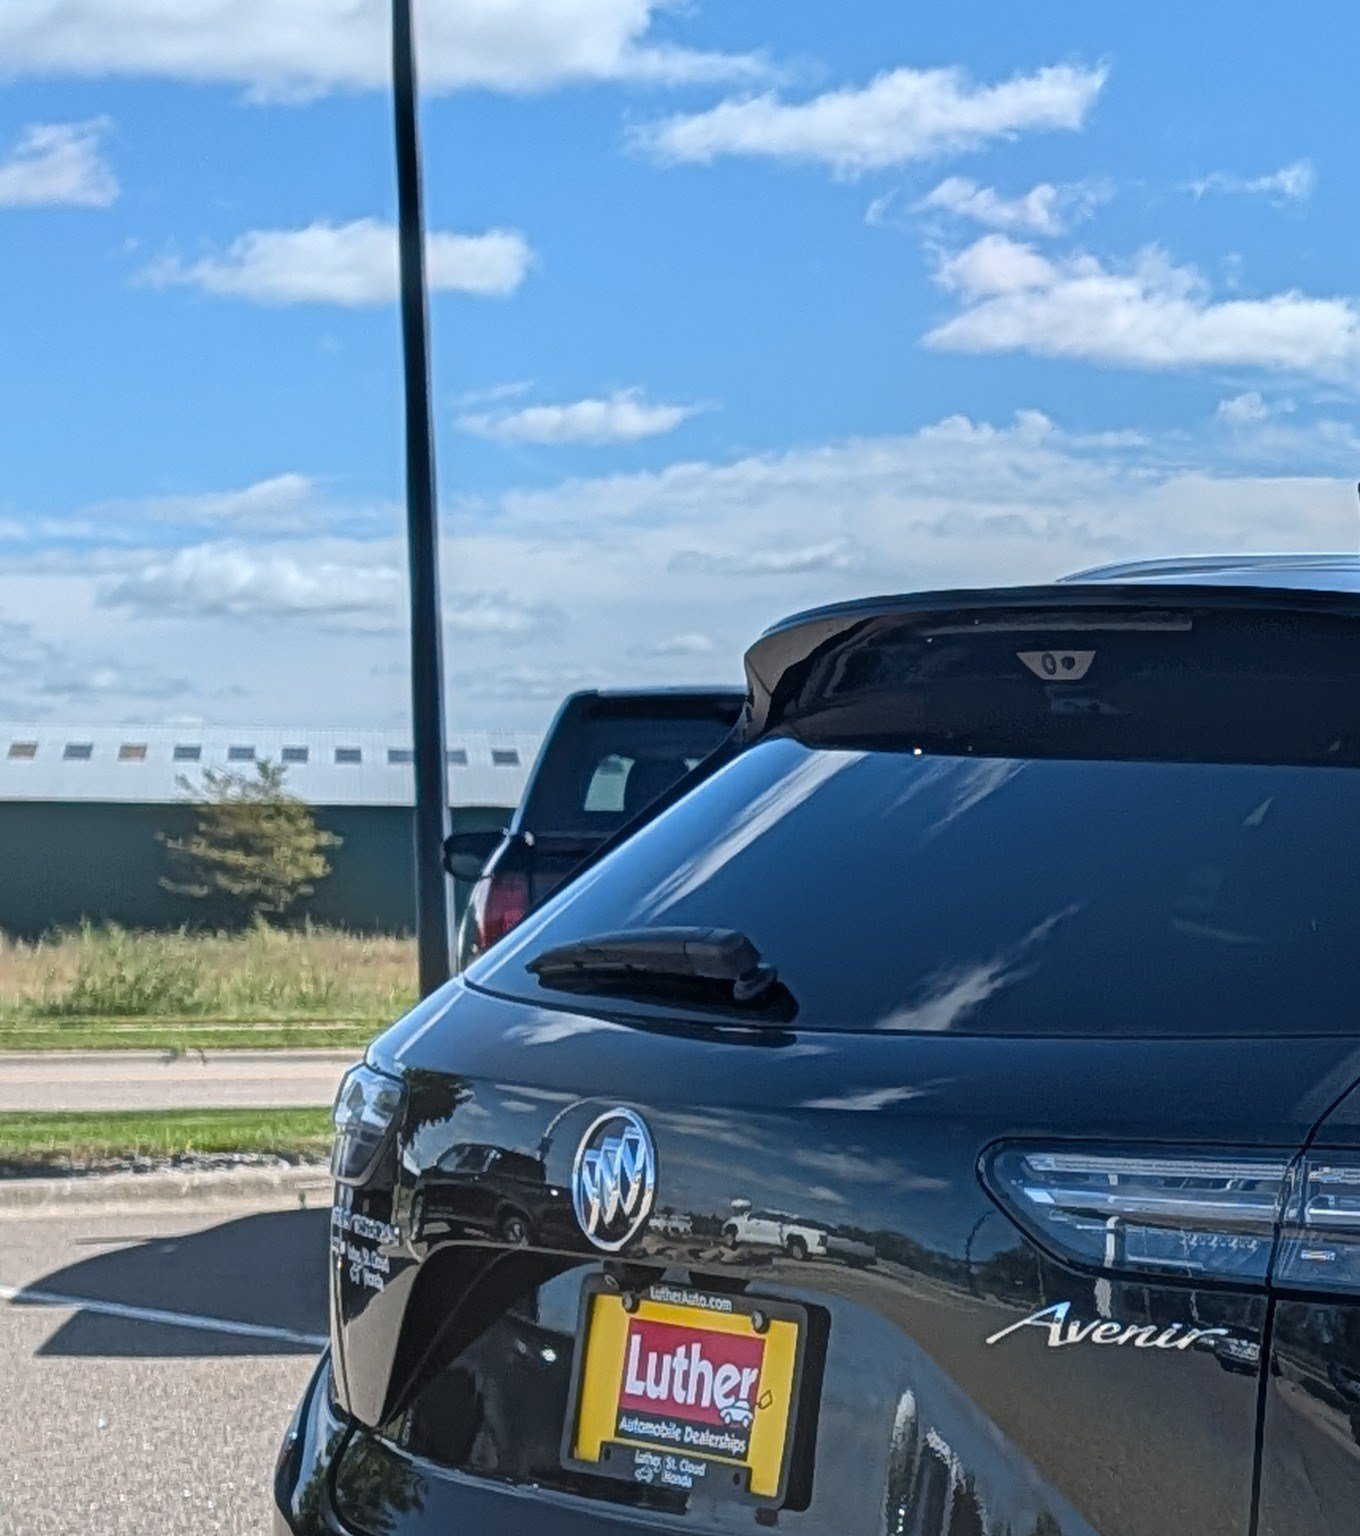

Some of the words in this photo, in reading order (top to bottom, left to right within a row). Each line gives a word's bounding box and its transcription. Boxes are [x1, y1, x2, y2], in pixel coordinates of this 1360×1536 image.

[986, 1301, 1229, 1350] Avenir
[624, 1333, 759, 1409] Luther
[619, 1416, 682, 1441] Automobile
